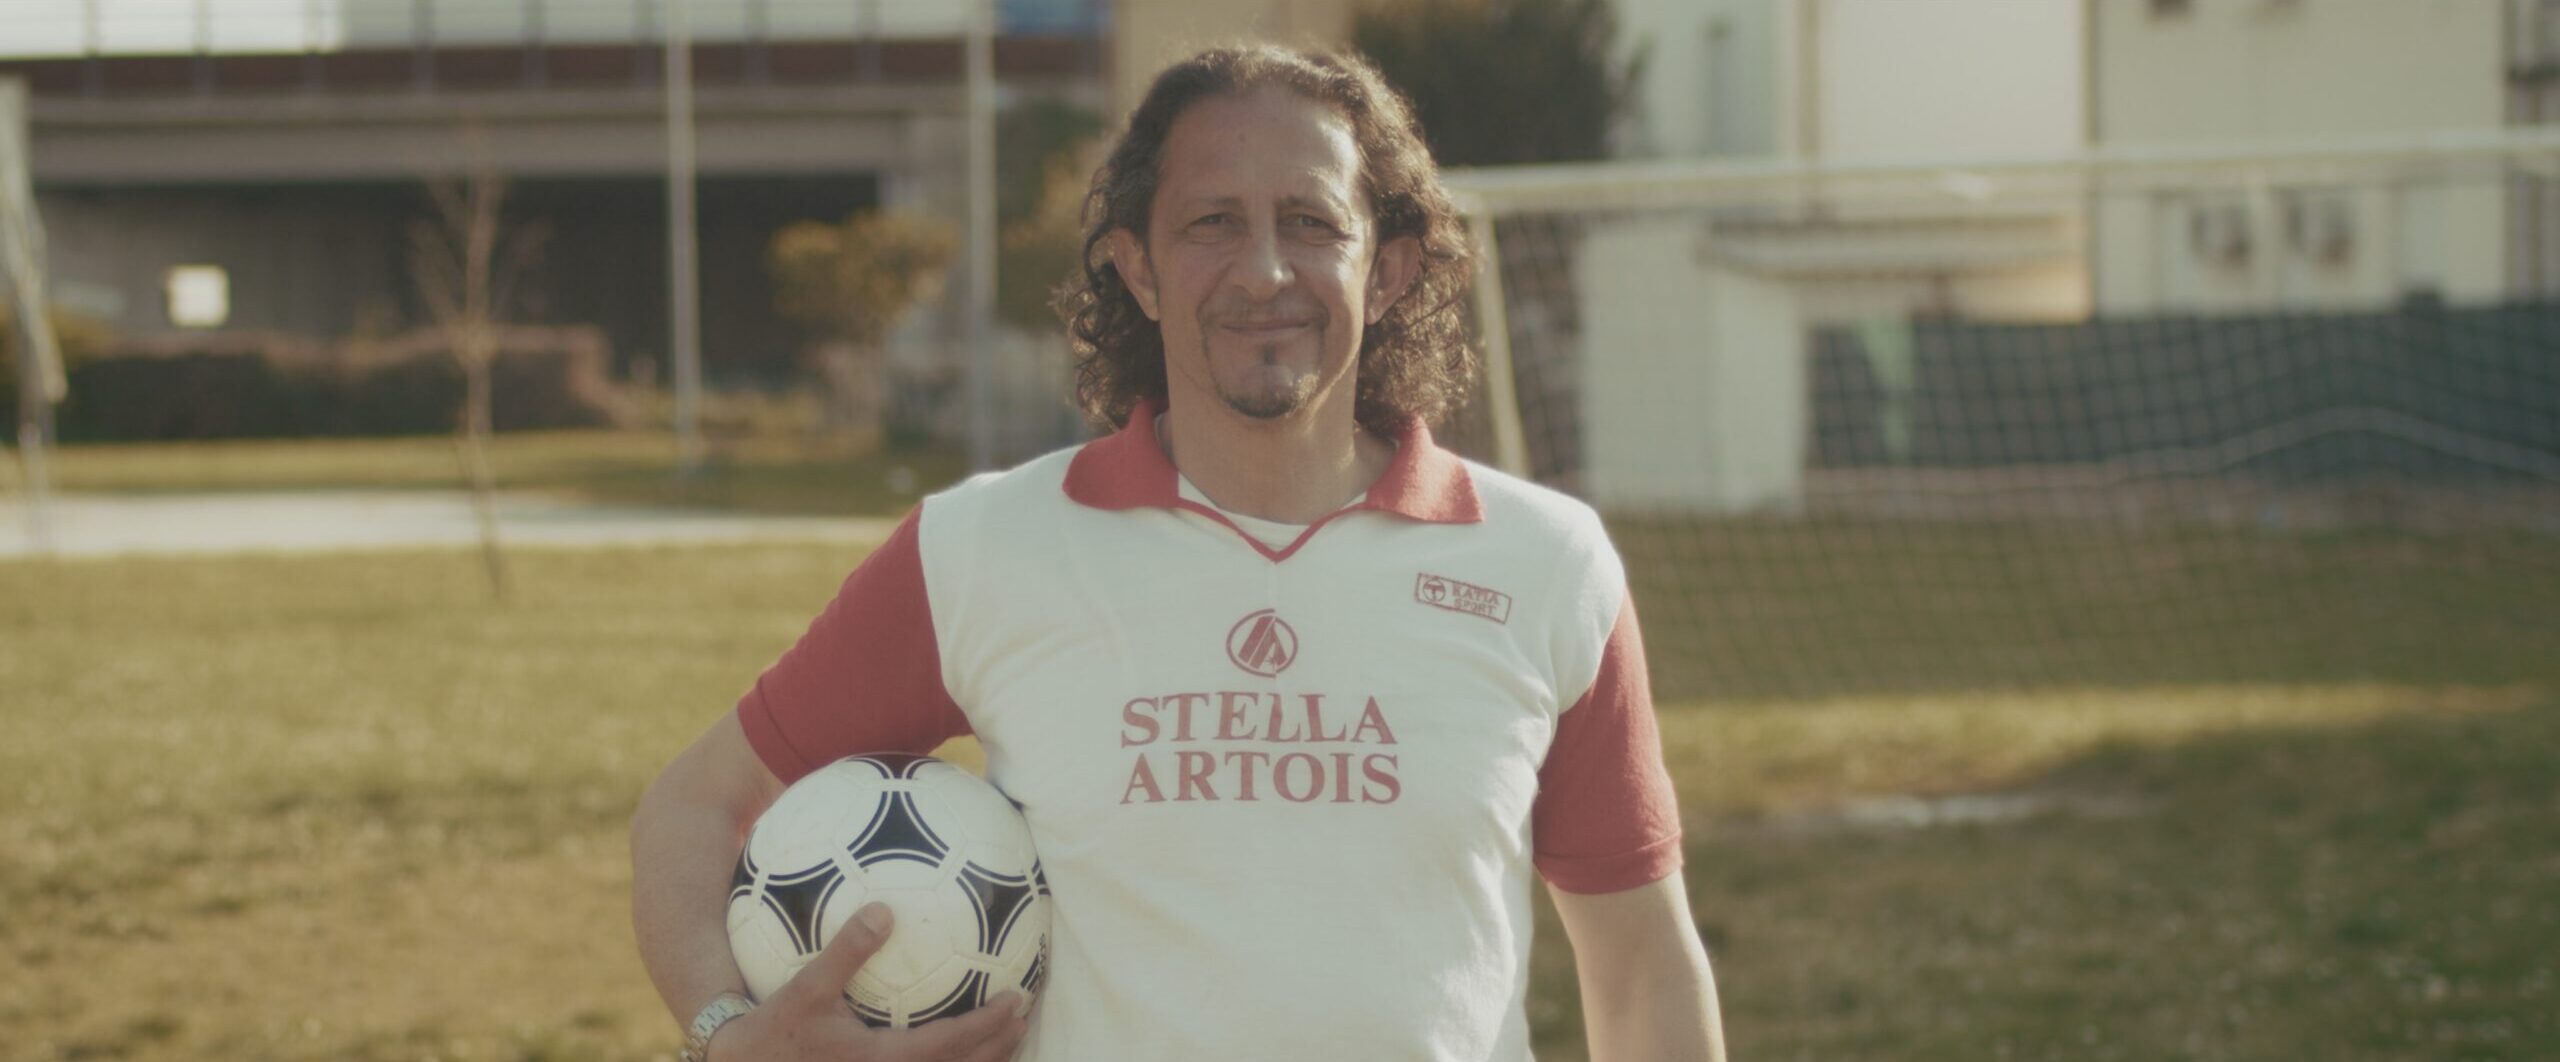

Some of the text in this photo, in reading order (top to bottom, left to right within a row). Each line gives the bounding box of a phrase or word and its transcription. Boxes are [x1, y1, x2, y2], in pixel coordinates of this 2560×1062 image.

[1455, 599, 1496, 616] SPORT
[1121, 691, 1398, 748] STELLA
[1119, 750, 1401, 805] ARTOIS
